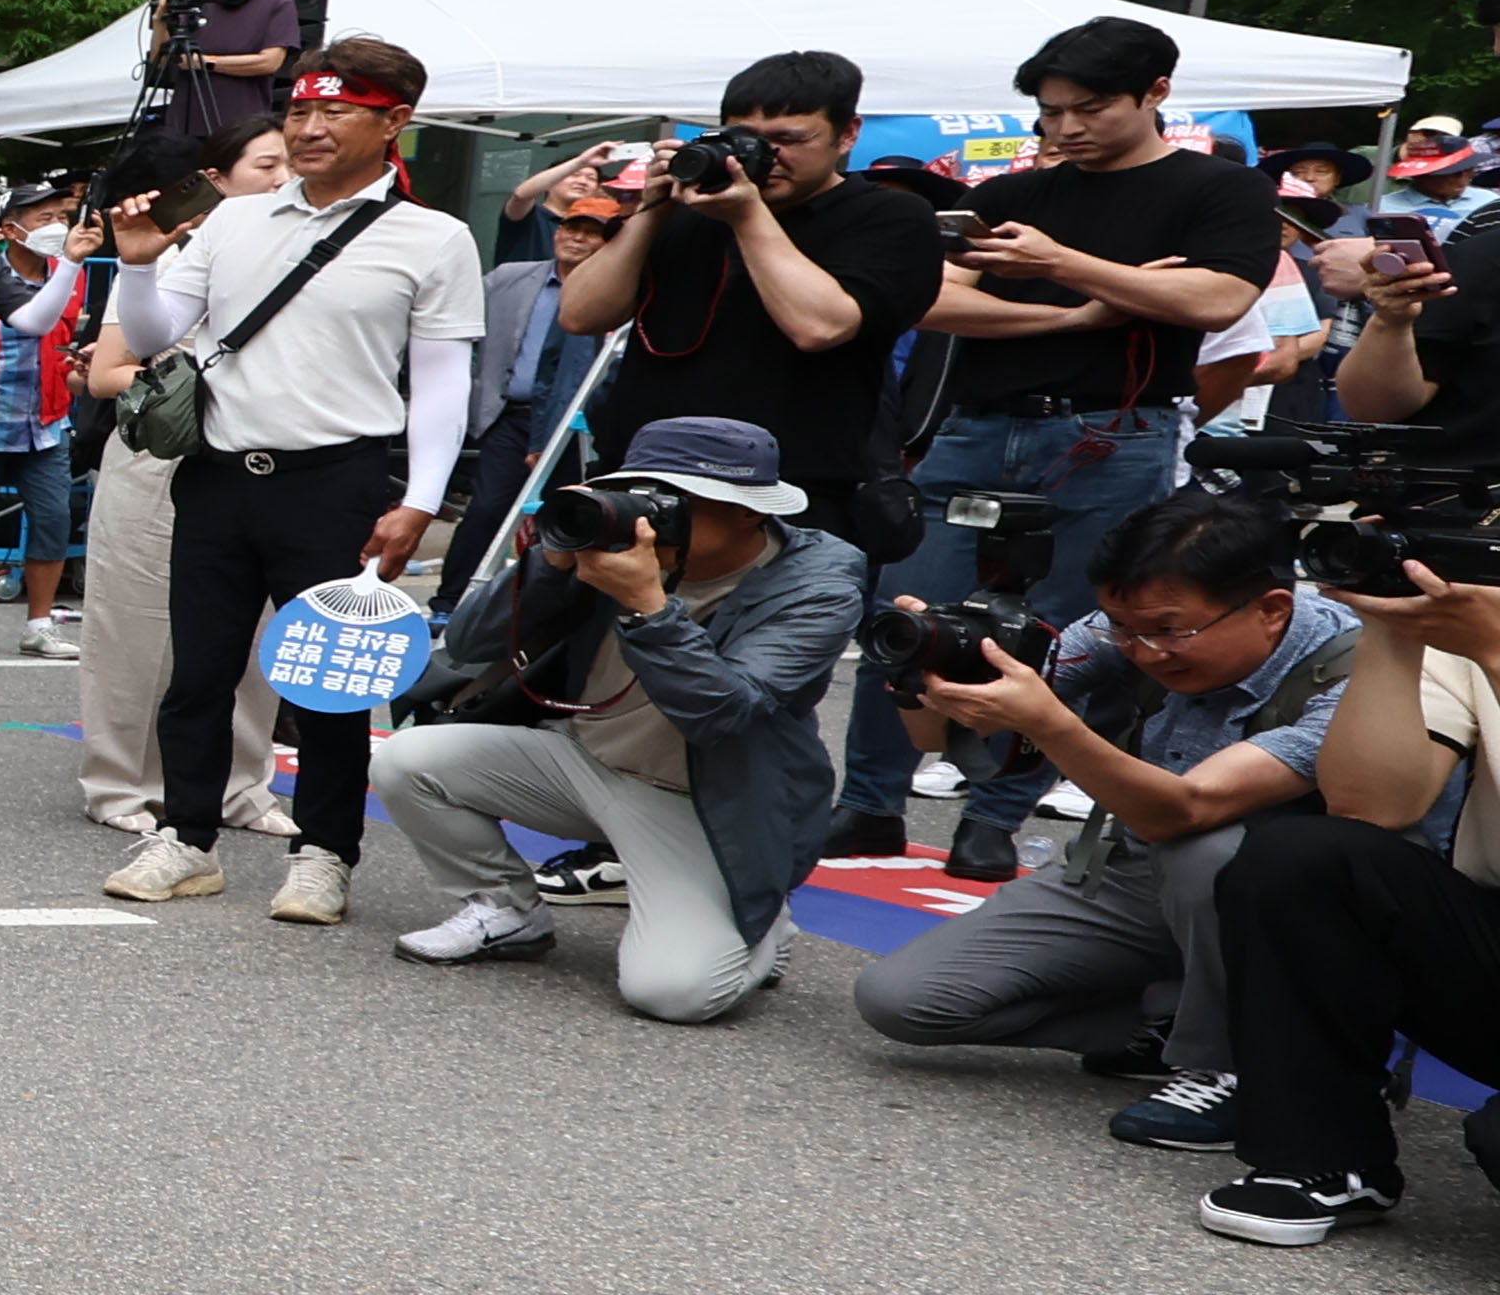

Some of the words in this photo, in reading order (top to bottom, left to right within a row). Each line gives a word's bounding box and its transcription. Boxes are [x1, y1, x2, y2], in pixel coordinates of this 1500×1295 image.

[284, 619, 330, 643] 거부
[337, 626, 410, 655] 용산은
[276, 640, 324, 666] 방관
[330, 648, 403, 678] 정부는
[268, 661, 318, 687] 외면
[321, 669, 395, 699] 농협은
